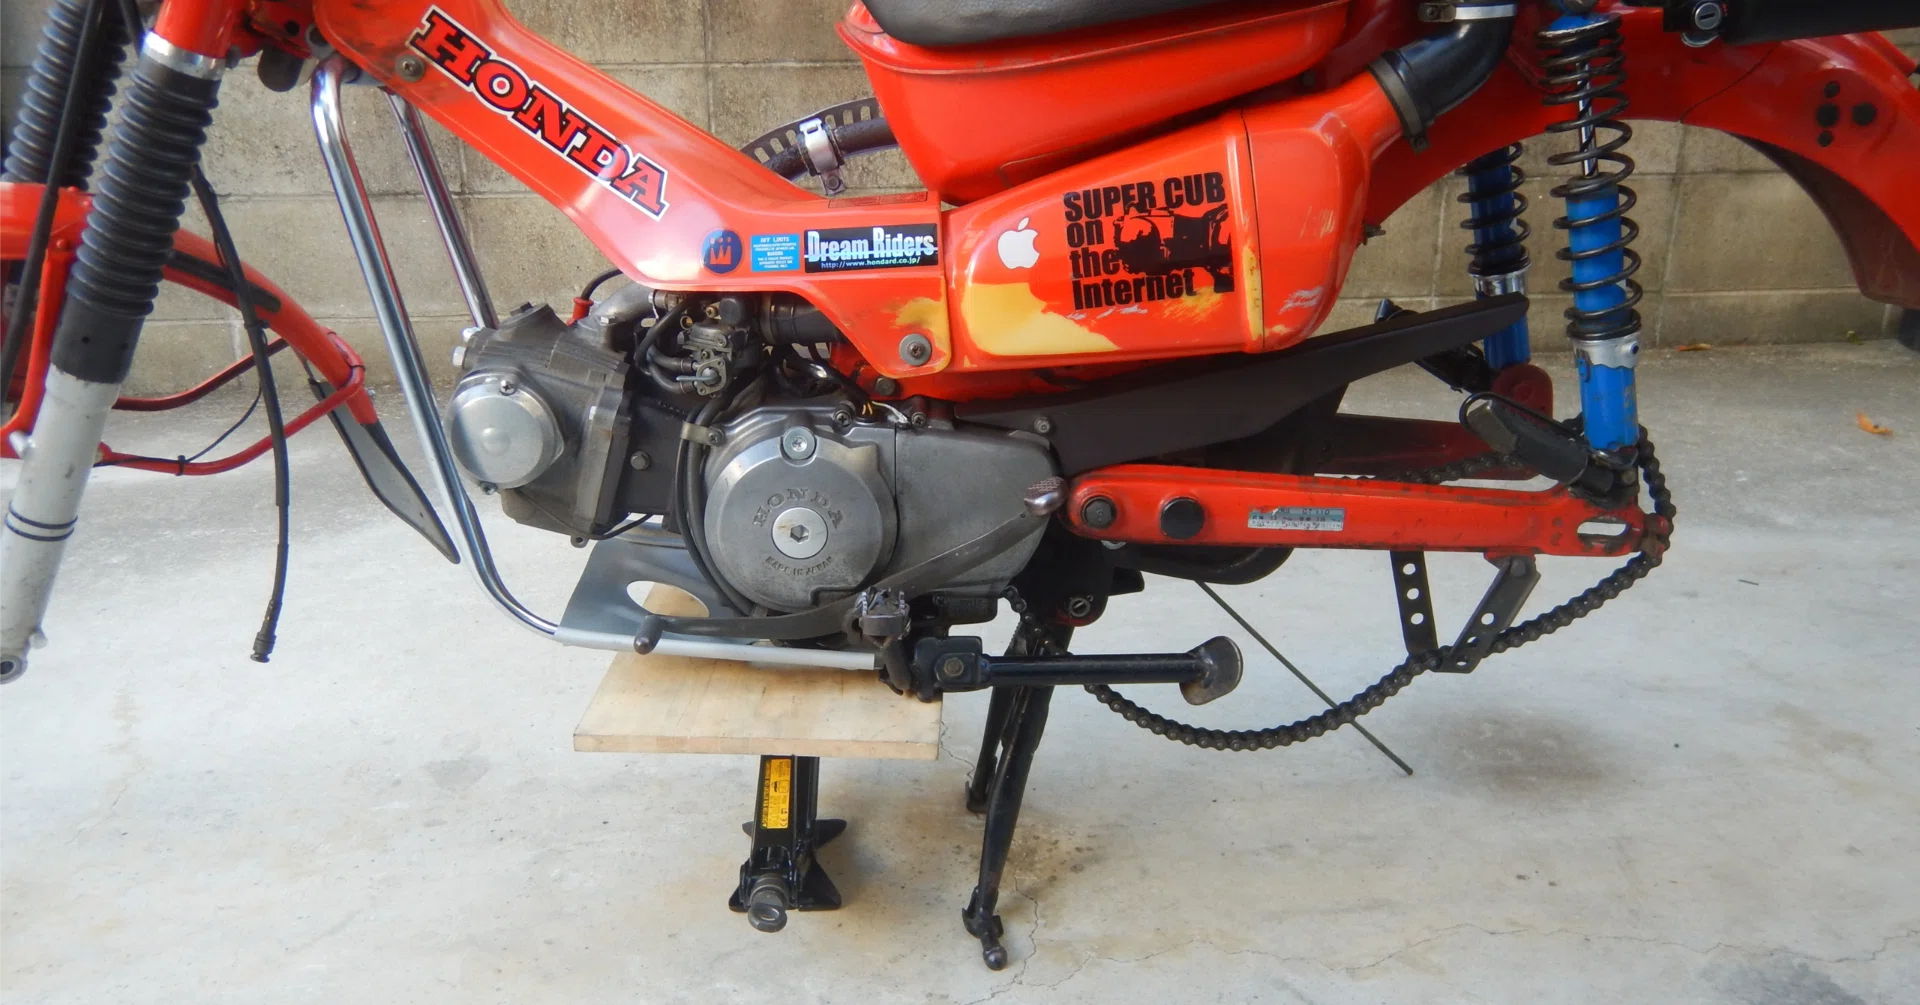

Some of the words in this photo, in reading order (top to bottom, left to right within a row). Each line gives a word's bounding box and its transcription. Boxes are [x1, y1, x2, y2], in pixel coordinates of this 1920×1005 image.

[408, 9, 668, 218] HONDA
[1063, 181, 1156, 222] SUPER
[1163, 172, 1226, 209] CUB
[807, 231, 869, 262] Dream
[872, 227, 934, 258] Riders
[1066, 220, 1104, 248] on
[821, 256, 920, 269] http://www.hondard.co.jp/
[1069, 246, 1121, 279] the
[1072, 268, 1196, 310] Internet
[752, 488, 844, 529] HONDA
[765, 556, 790, 573] MADE
[793, 568, 803, 576] IN
[806, 555, 834, 575] JAPAN
